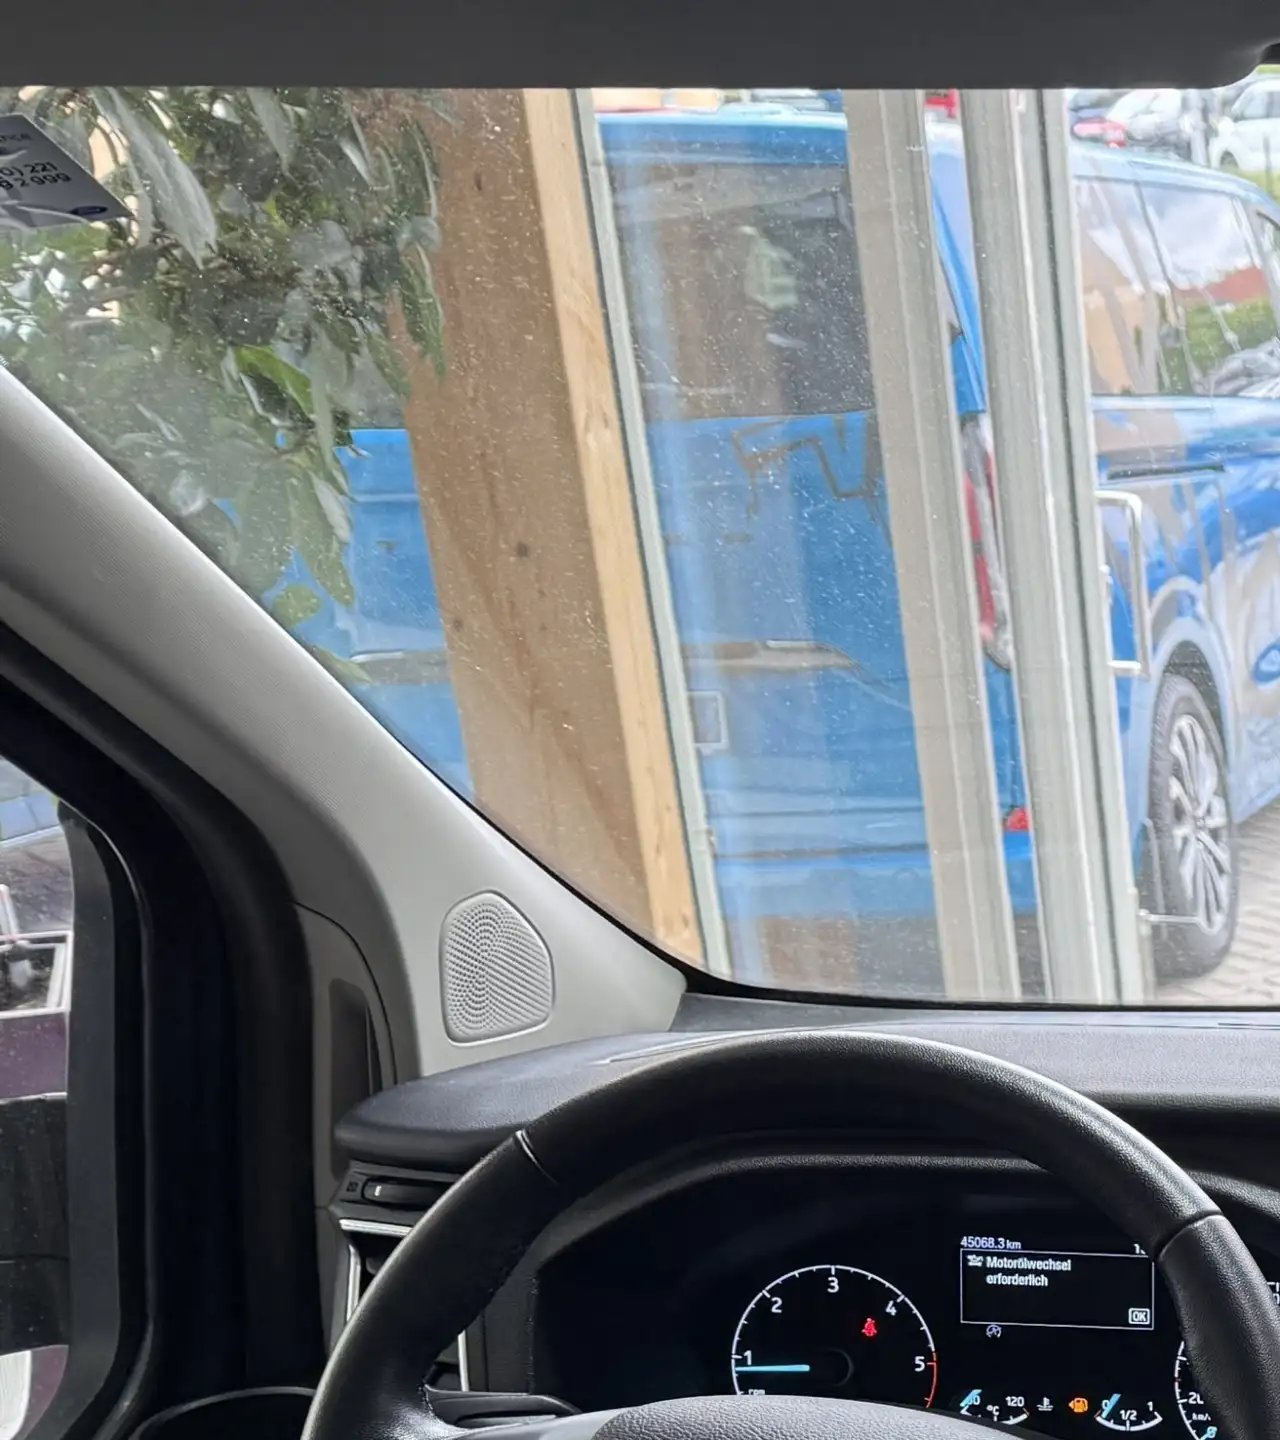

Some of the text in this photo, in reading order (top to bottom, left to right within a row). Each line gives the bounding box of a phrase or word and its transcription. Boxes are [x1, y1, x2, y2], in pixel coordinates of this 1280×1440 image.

[24, 161, 58, 174] 221
[960, 1235, 1022, 1250] 45068.3 km
[986, 1254, 1071, 1271] Motorölwechsel
[827, 1276, 839, 1293] 3
[986, 1274, 1049, 1287] erforderlich
[771, 1297, 782, 1313] 2
[885, 1301, 897, 1316] 4
[1132, 1312, 1147, 1323] OK
[744, 1350, 751, 1365] 1
[914, 1356, 925, 1372] 5
[1005, 1396, 1025, 1407] 120
[1147, 1401, 1153, 1412] 1
[1119, 1410, 1138, 1421] 1/2
